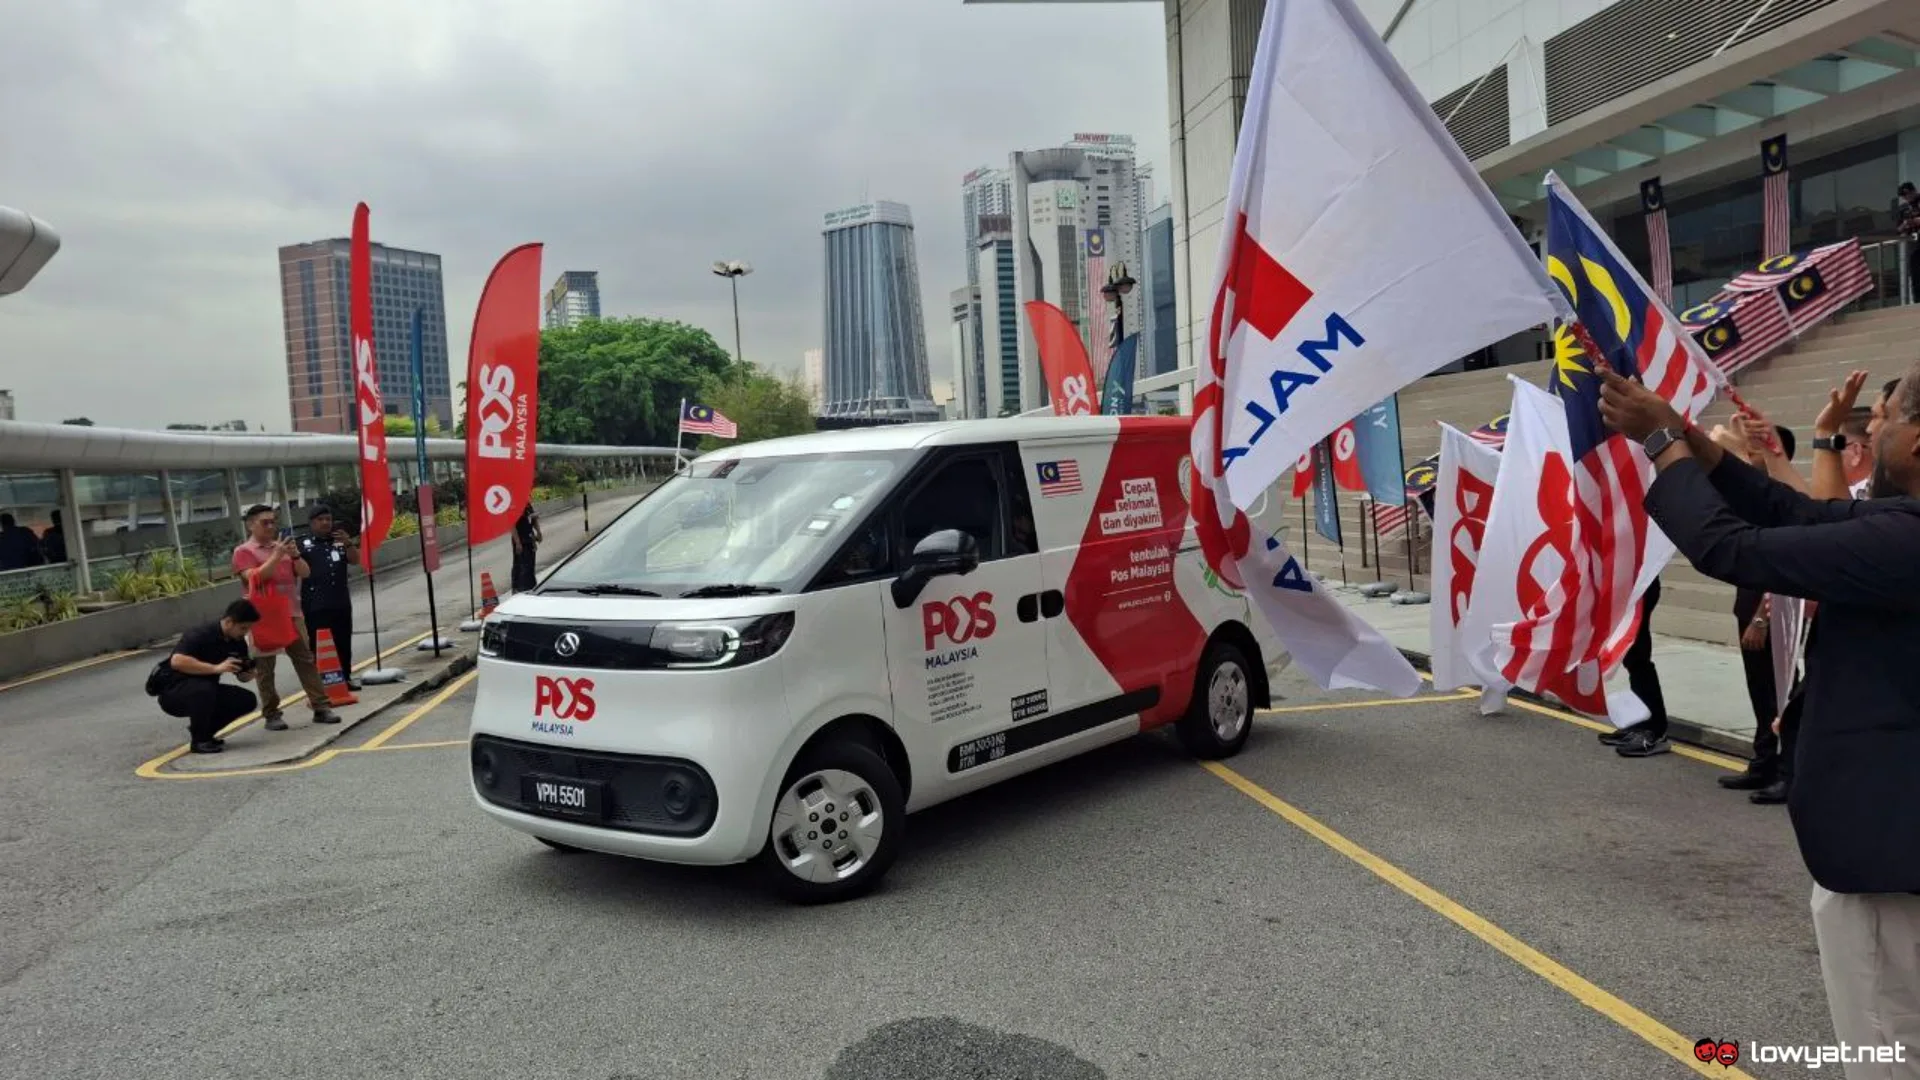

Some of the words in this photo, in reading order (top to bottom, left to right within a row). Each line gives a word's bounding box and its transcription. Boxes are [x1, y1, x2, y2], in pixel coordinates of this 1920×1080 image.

[478, 363, 515, 459] POS
[515, 393, 528, 460] MALAYSIA
[1103, 517, 1121, 529] dan
[1124, 511, 1161, 528] diyakini
[1130, 545, 1169, 563] tentulah
[1111, 570, 1129, 584] Pos
[1130, 561, 1170, 579] Malaysia
[922, 591, 997, 651] POS
[925, 646, 978, 669] MALAYSIA
[534, 675, 596, 721] POS
[531, 721, 574, 736] MALAYSIA
[536, 782, 557, 804] VPH
[559, 785, 586, 807] 5501
